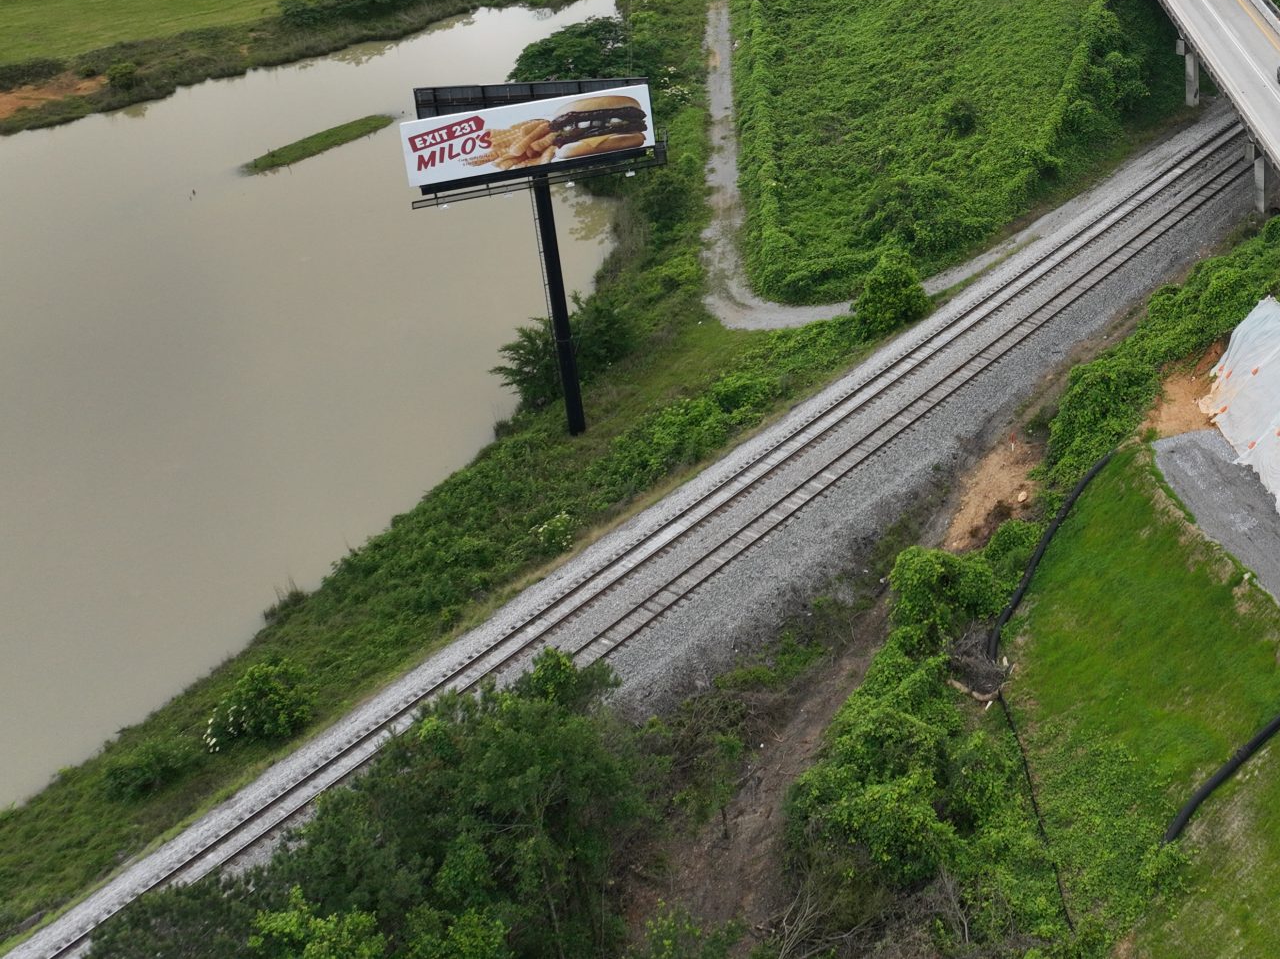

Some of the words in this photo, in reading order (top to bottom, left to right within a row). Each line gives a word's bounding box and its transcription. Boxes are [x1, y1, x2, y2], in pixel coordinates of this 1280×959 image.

[414, 129, 449, 149] EXIT
[452, 120, 477, 137] 231
[417, 131, 492, 171] MILO'S
